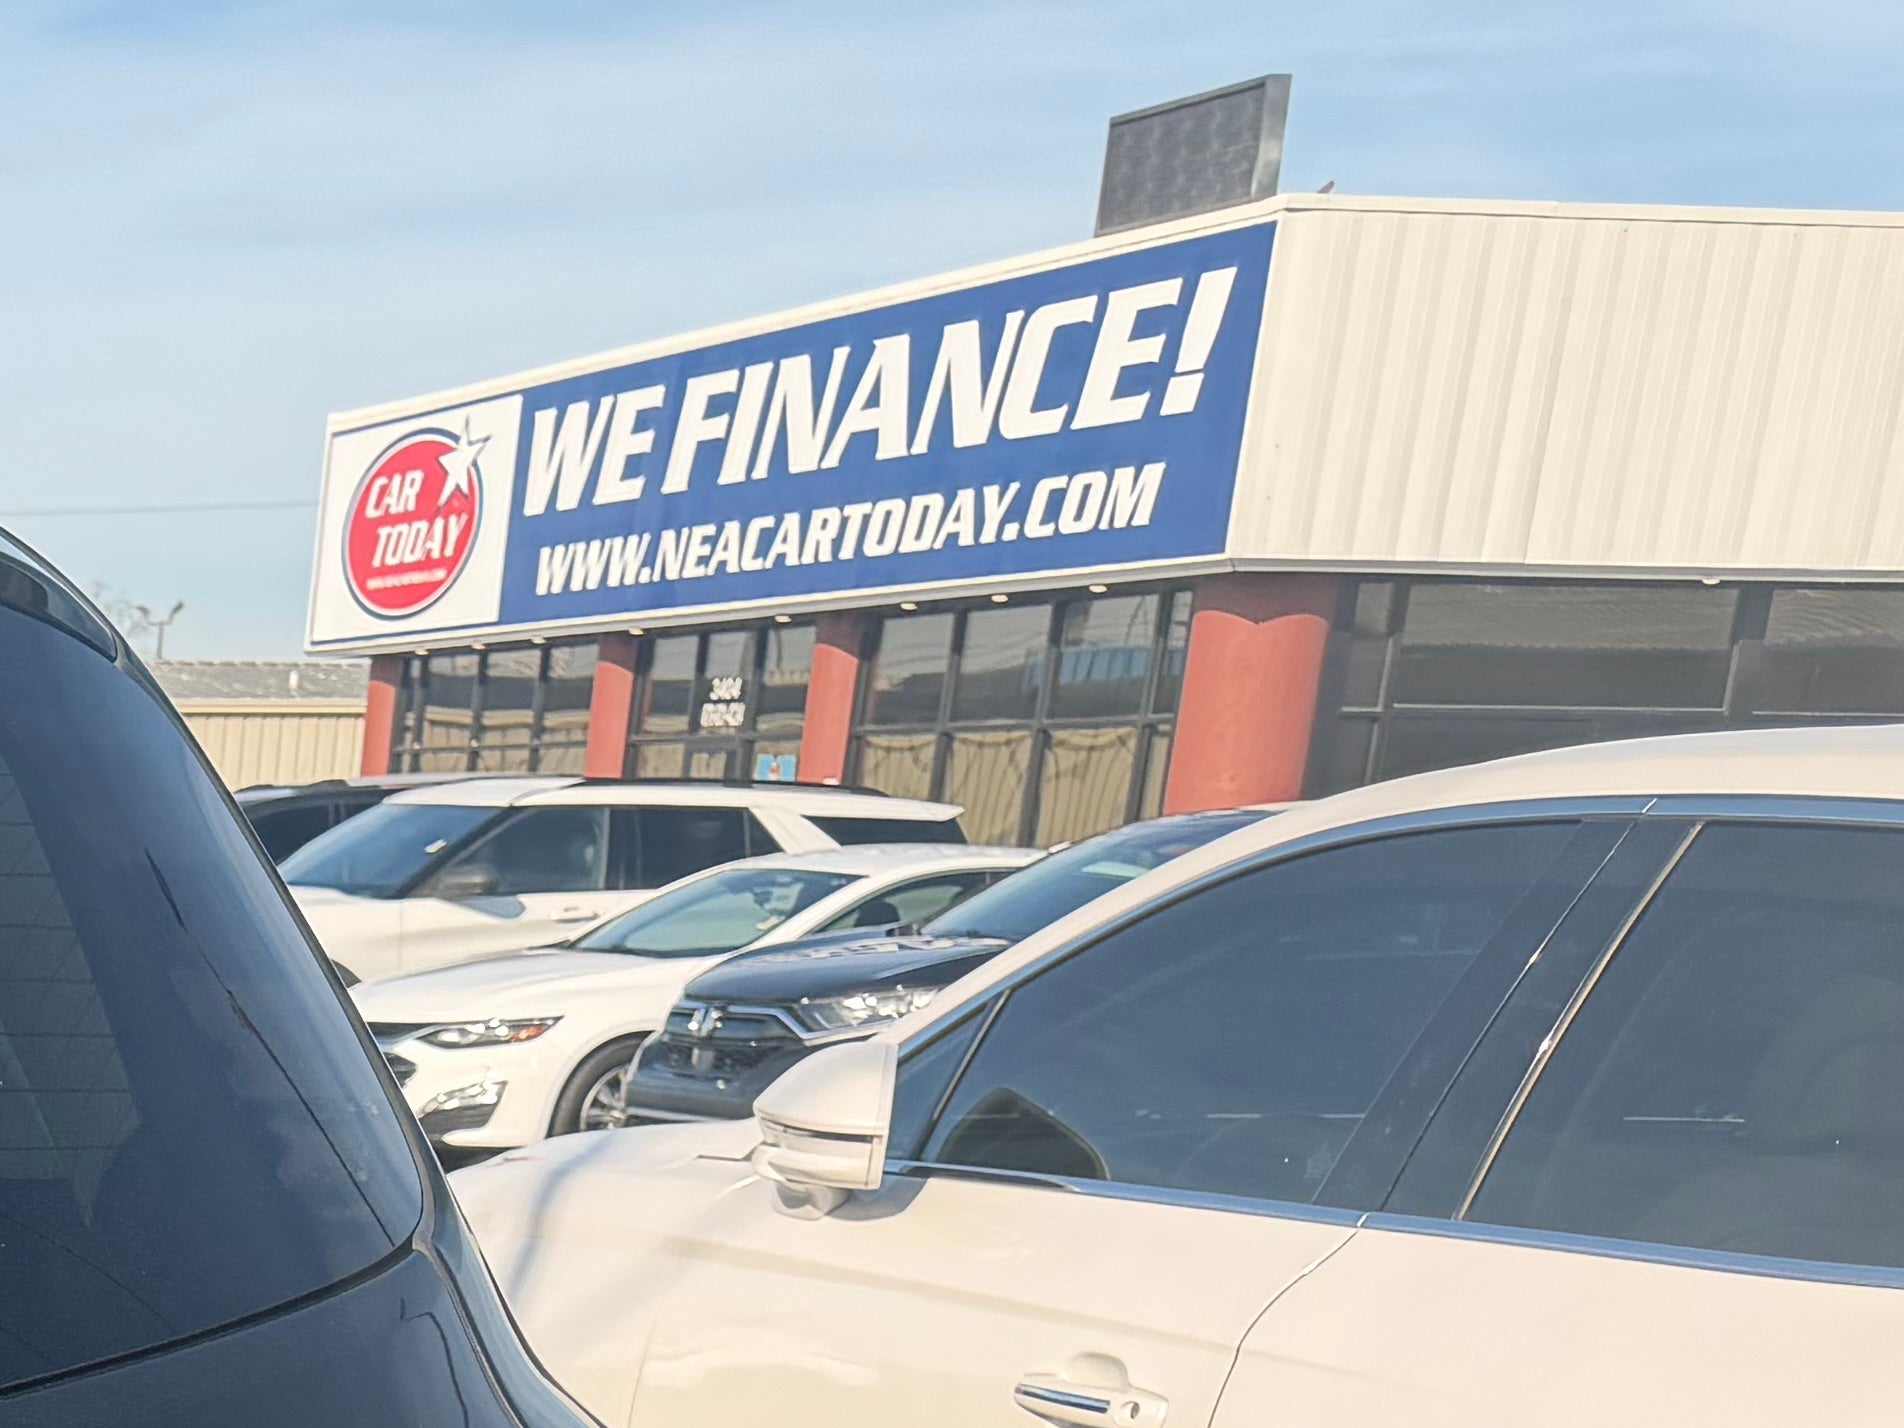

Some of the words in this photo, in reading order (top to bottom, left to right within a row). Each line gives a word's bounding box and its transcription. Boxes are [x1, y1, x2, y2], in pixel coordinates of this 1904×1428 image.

[523, 384, 666, 516] WE
[660, 267, 1237, 494] FINANCE!
[365, 469, 424, 518] CAR
[372, 512, 468, 567] TODAY
[535, 462, 1166, 595] WWW.NEACARTODAY.COM
